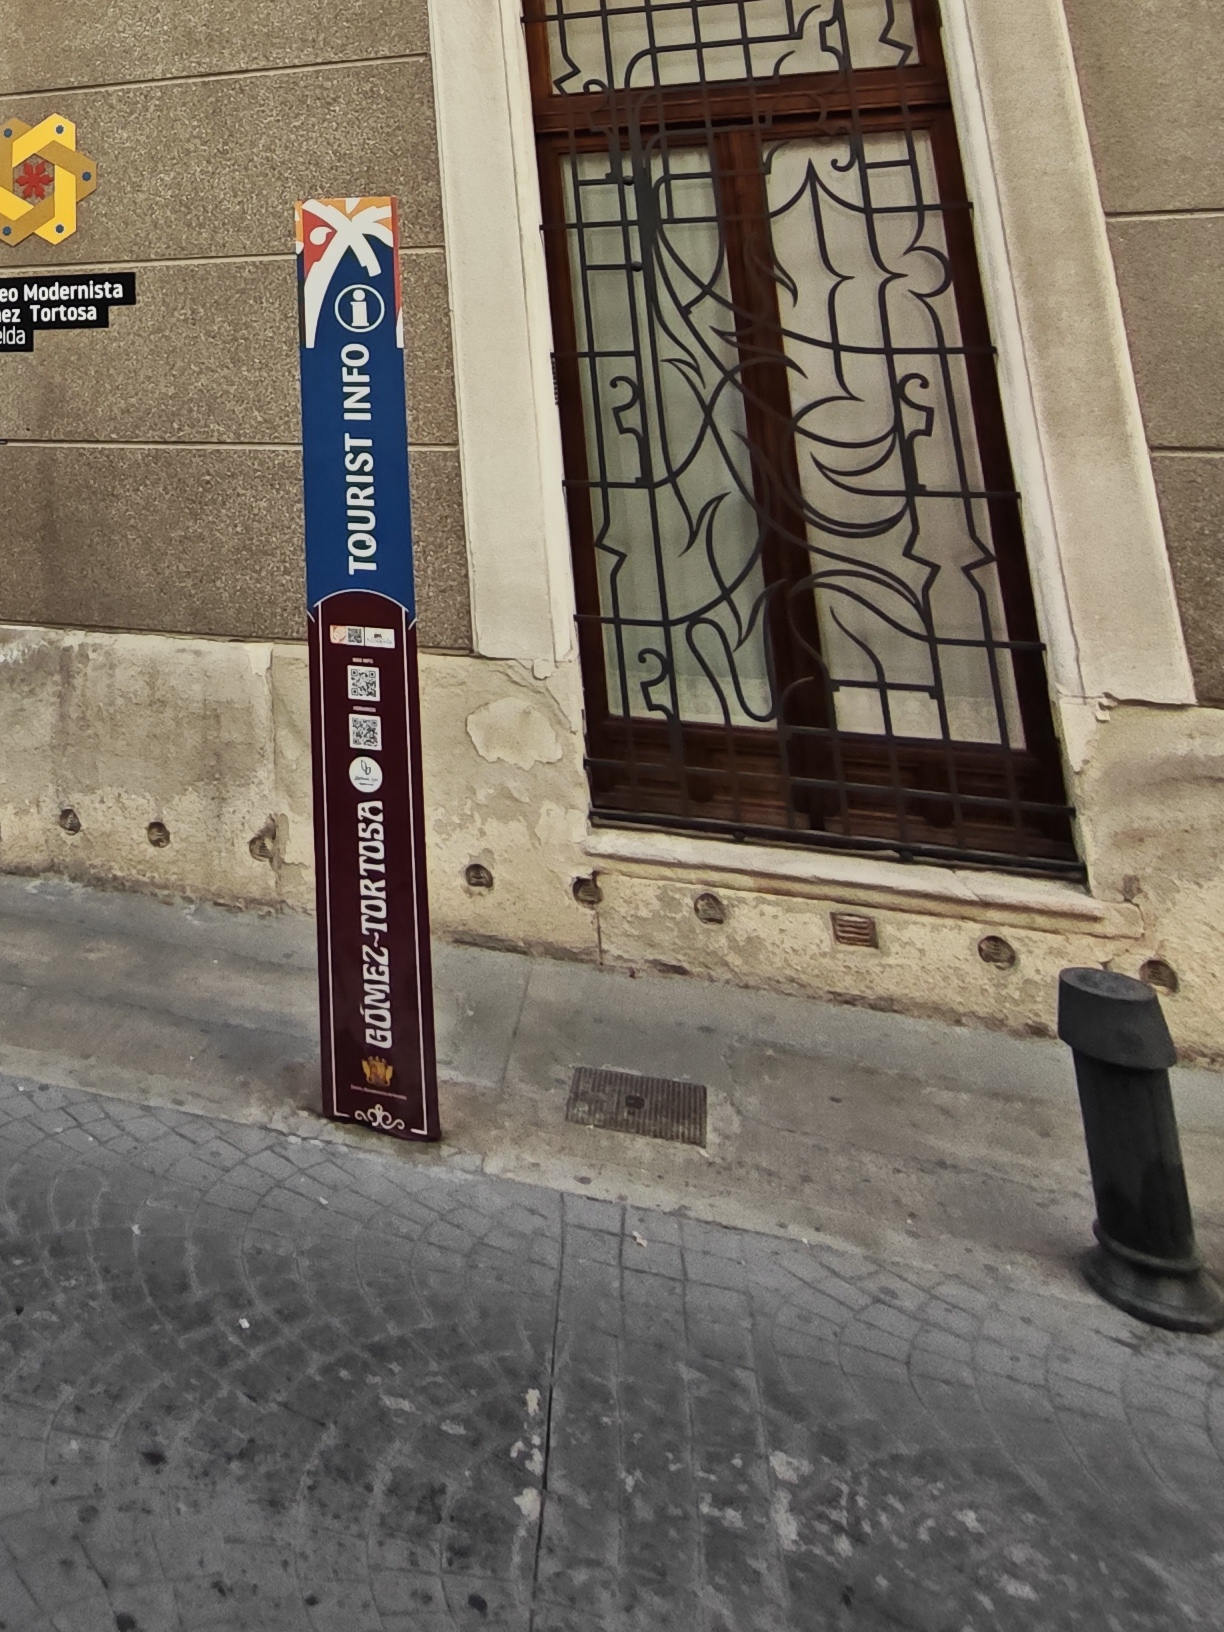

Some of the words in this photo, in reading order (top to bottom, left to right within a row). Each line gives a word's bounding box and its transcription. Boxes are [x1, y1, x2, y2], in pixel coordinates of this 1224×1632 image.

[23, 280, 123, 301] Modernista
[29, 304, 97, 322] Tortosa
[340, 343, 372, 421] INFO
[344, 432, 378, 576] TOURIST
